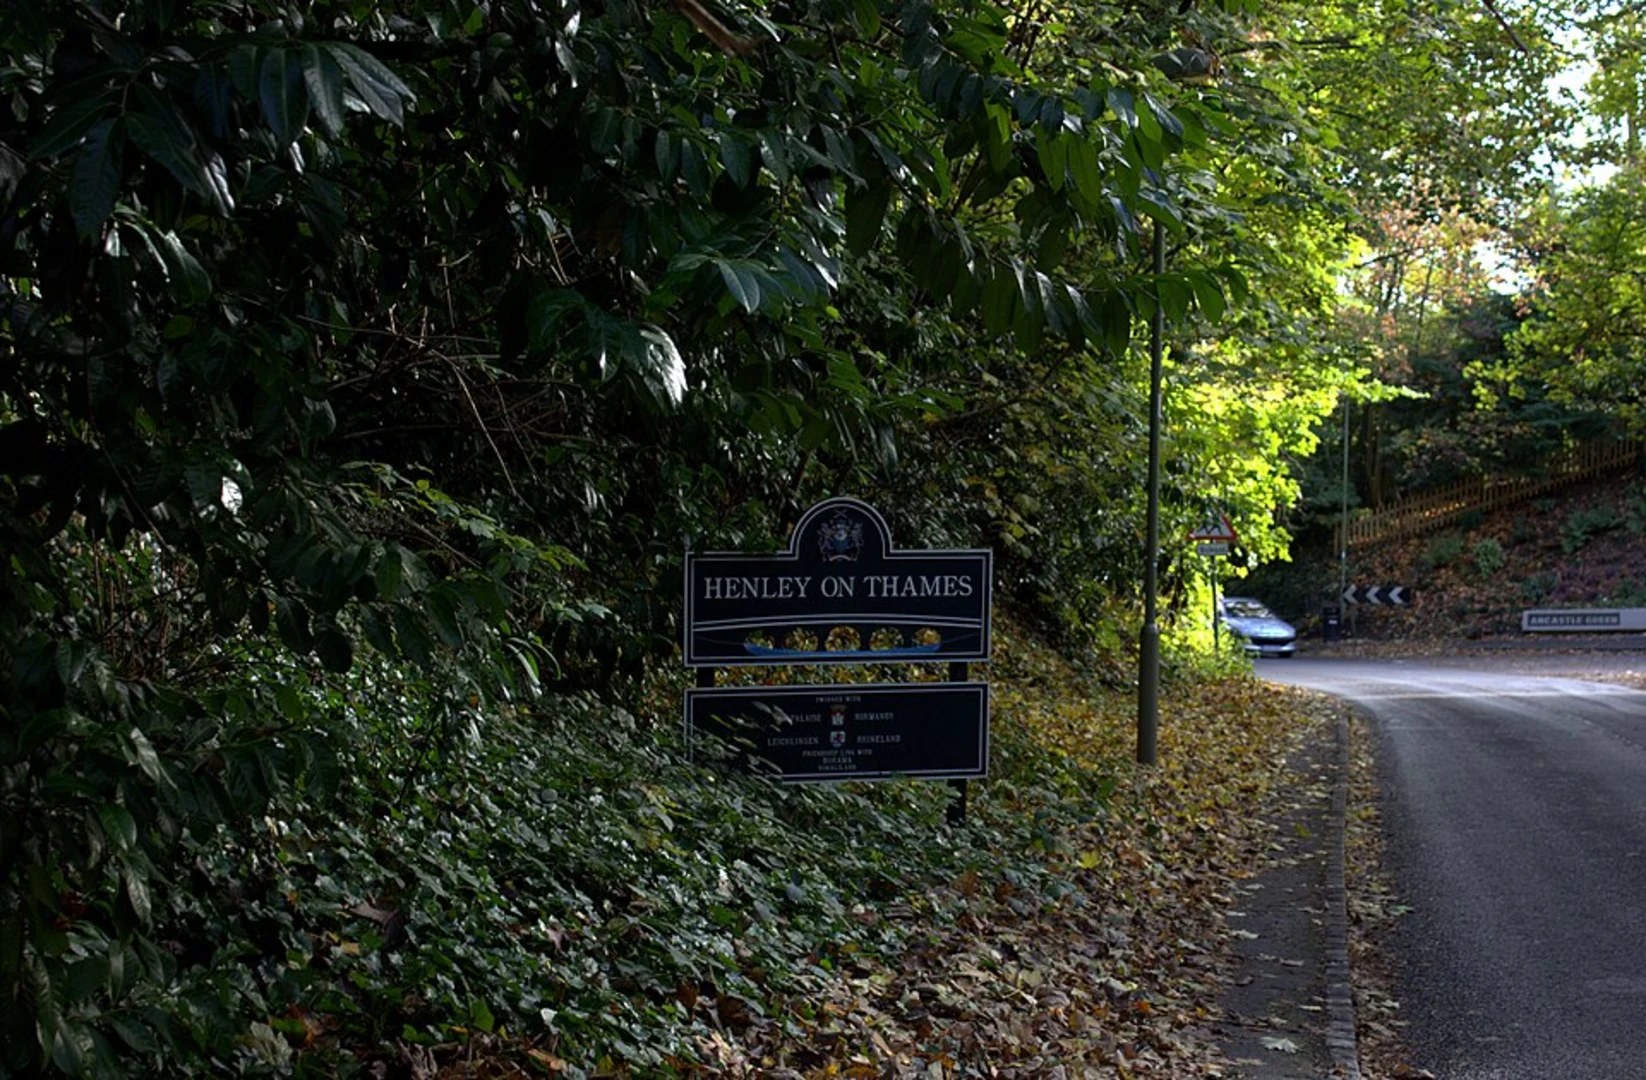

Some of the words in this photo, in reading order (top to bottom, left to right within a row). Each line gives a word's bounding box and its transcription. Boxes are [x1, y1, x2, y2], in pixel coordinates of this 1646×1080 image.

[703, 576, 812, 599] HENLEY
[820, 576, 855, 598] ON
[863, 575, 973, 598] THAMES
[854, 712, 894, 721] NORMANDY
[857, 734, 901, 744] RHINELAND
